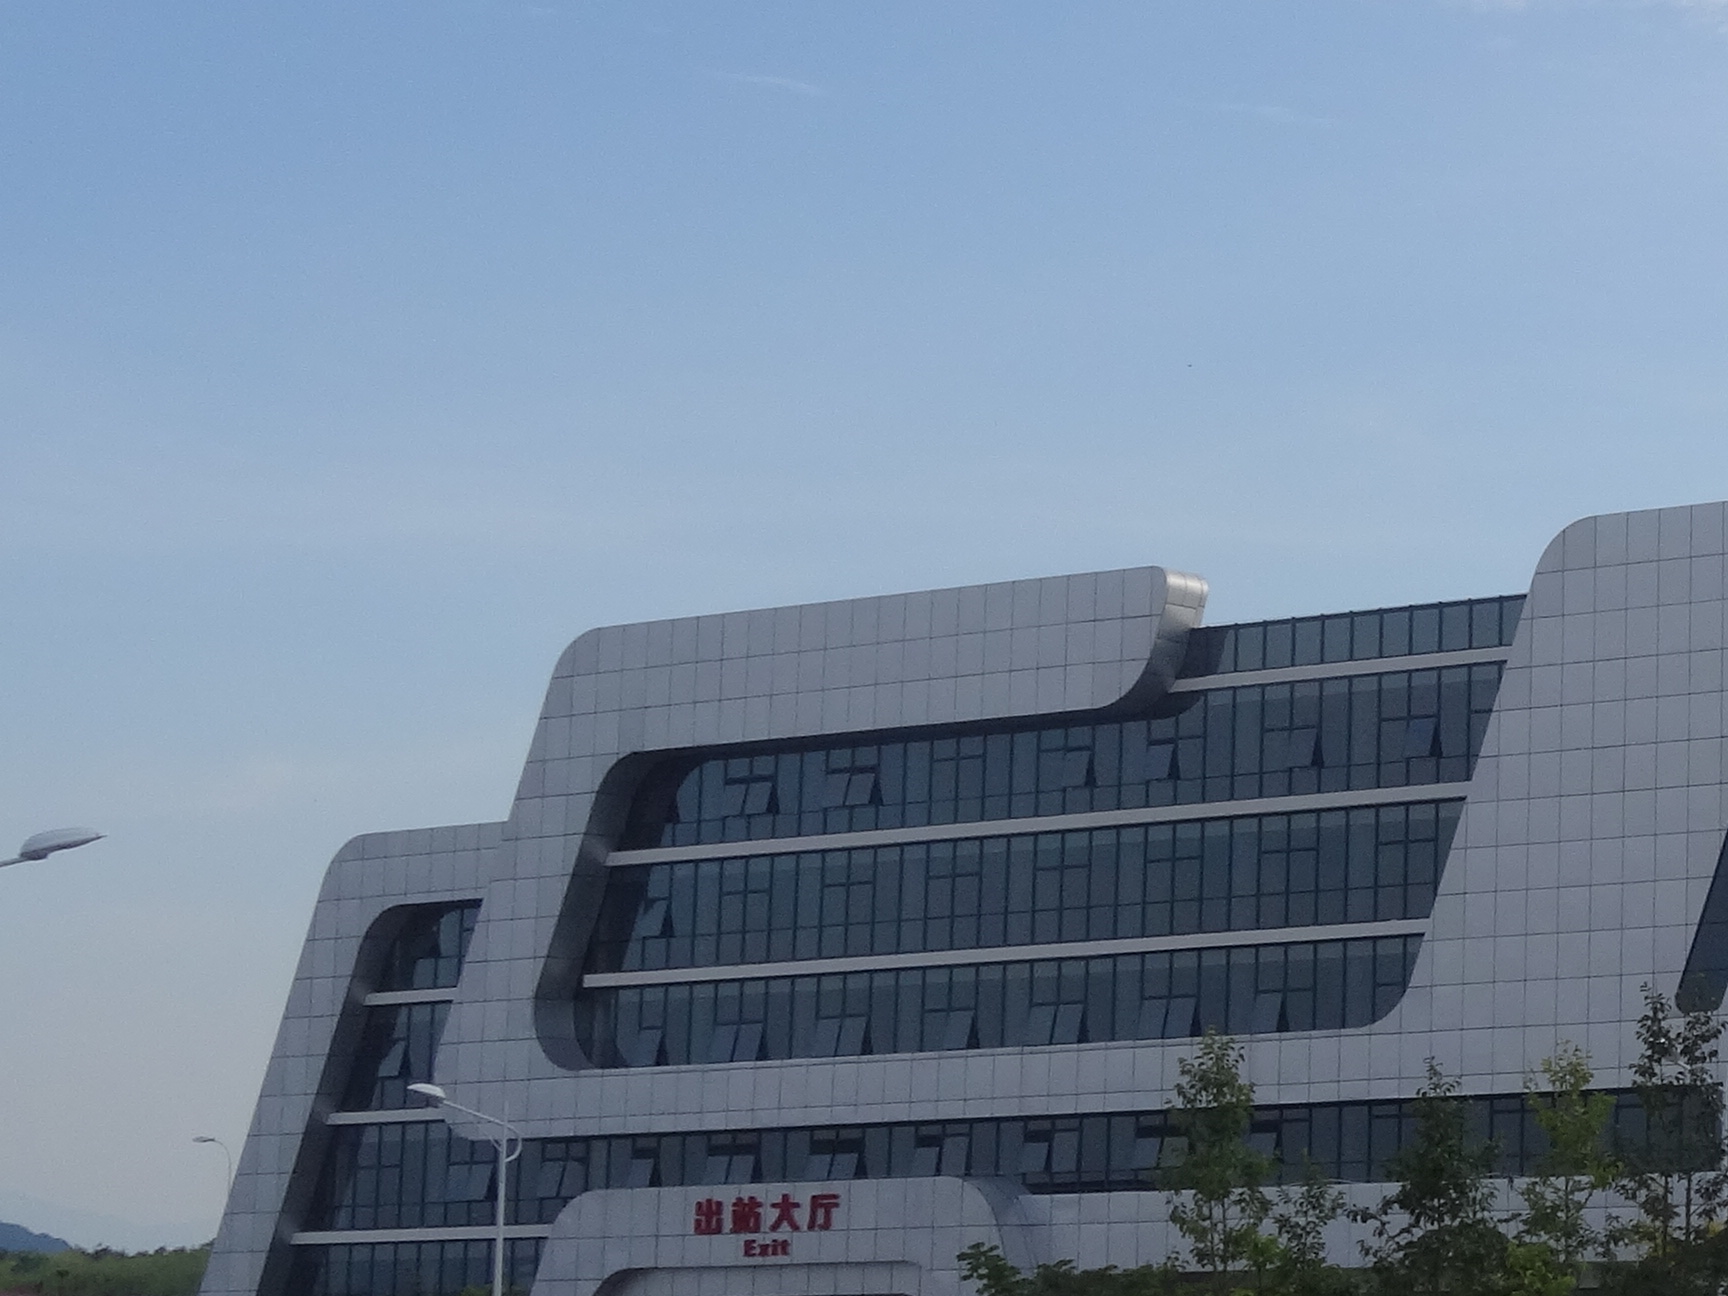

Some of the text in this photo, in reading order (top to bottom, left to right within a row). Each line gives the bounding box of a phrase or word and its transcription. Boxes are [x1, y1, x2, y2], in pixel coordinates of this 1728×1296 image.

[694, 1194, 841, 1235] 出站大厅
[744, 1239, 790, 1257] Exit
